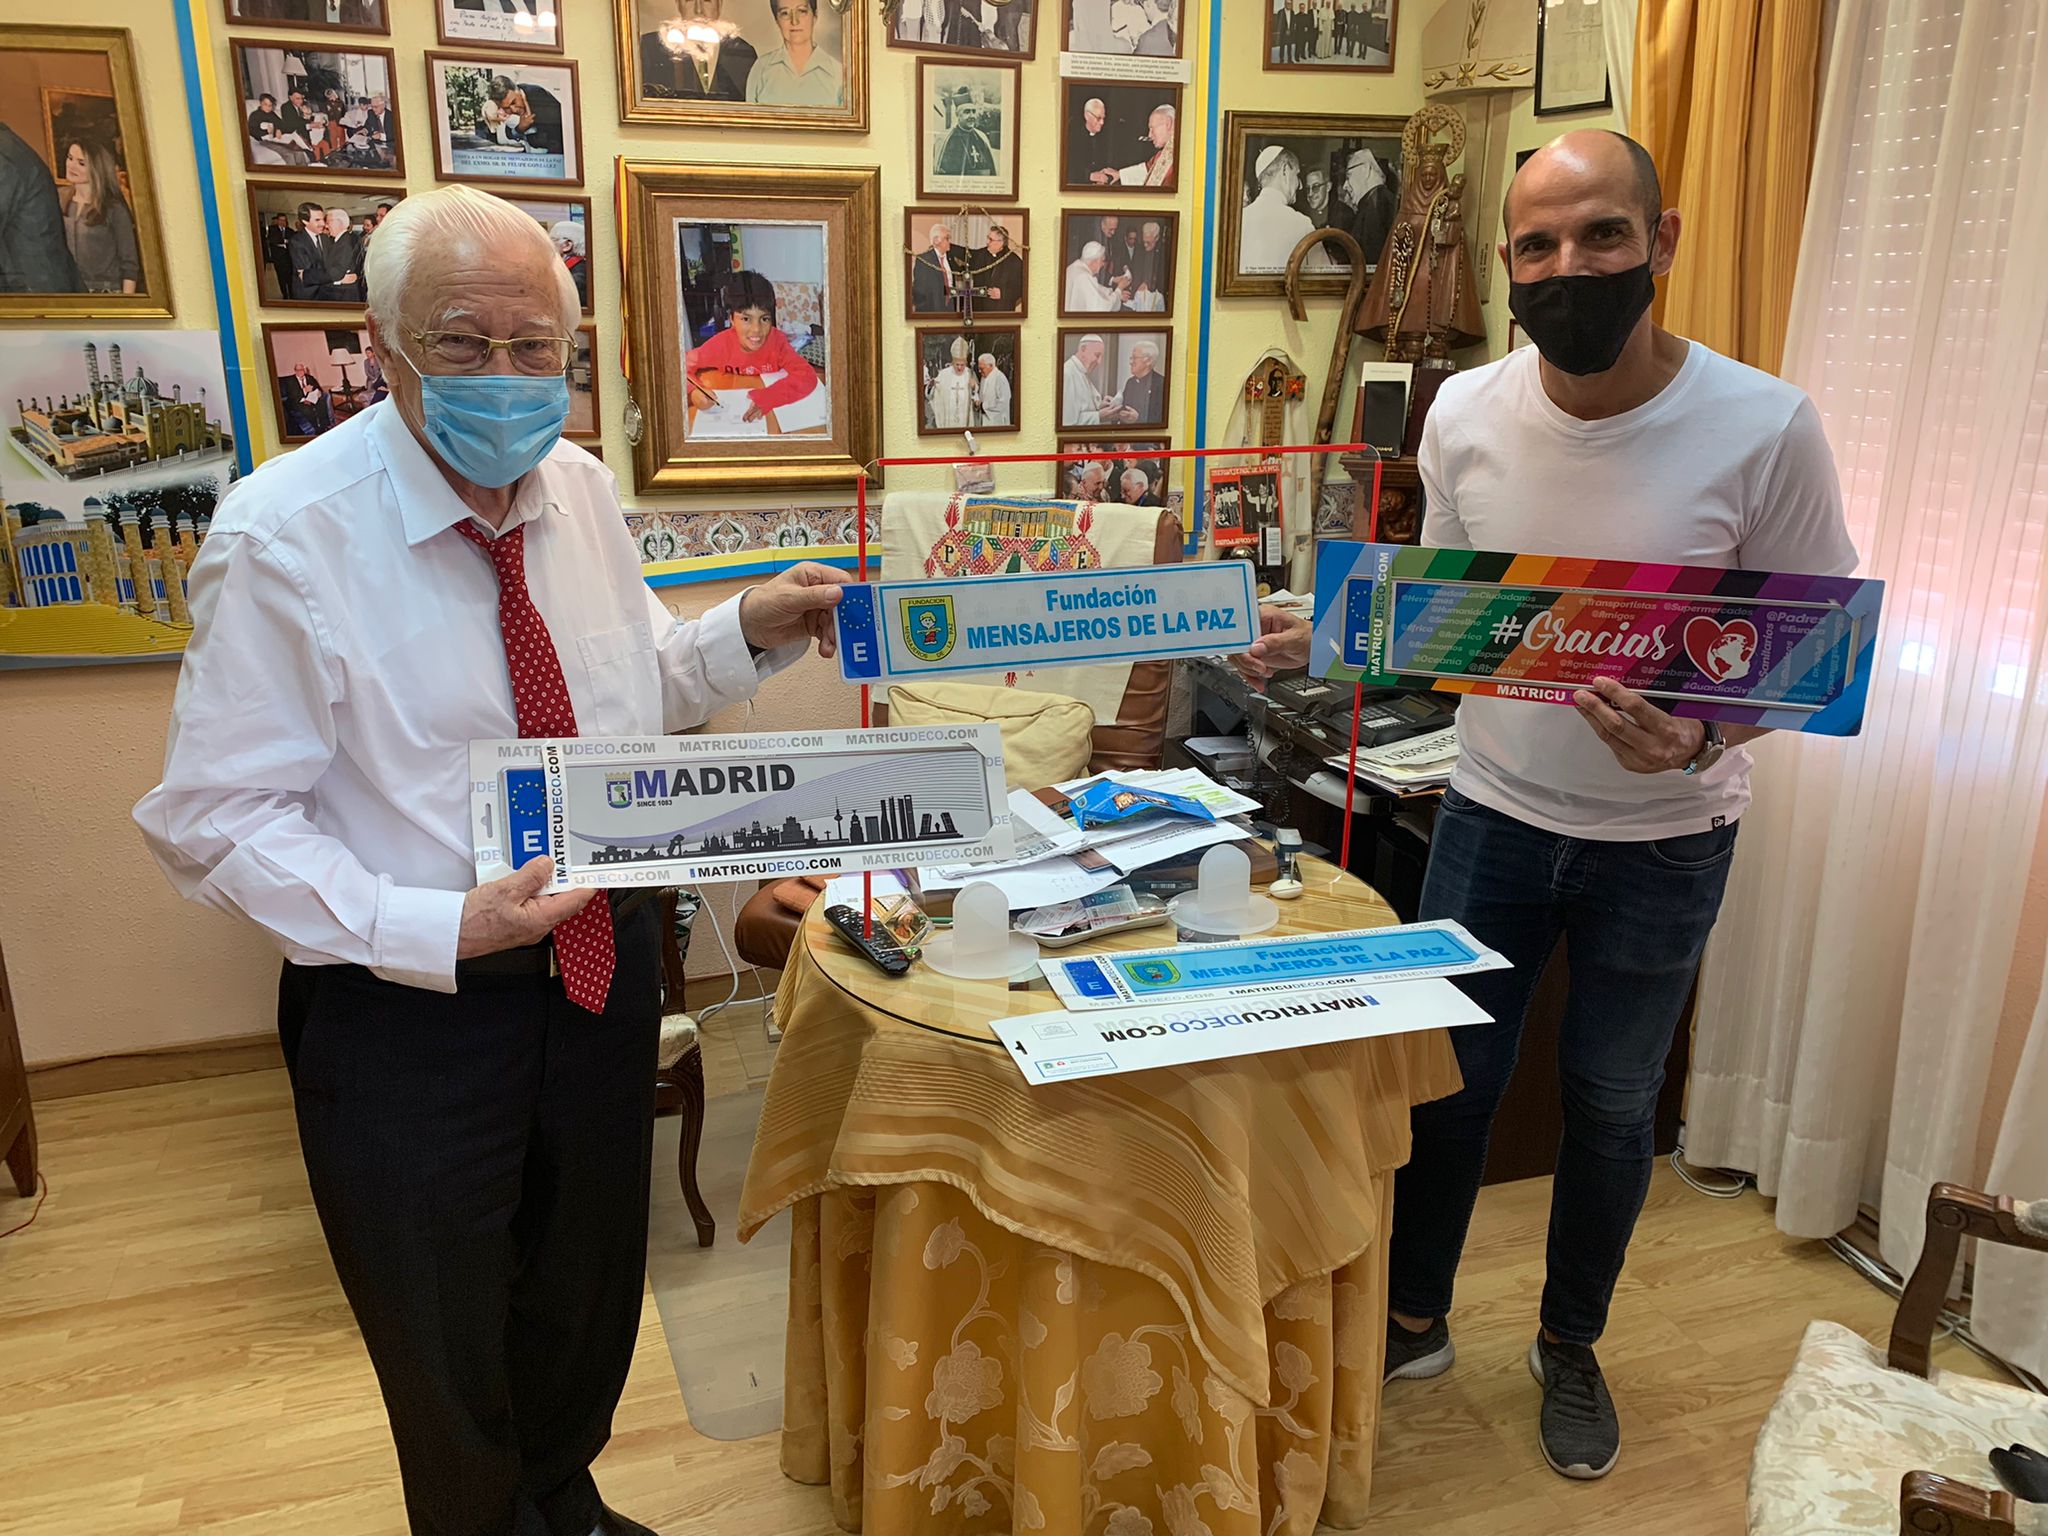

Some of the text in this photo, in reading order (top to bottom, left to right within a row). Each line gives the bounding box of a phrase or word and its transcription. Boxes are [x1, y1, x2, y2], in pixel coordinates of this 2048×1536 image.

[943, 544, 955, 564] P
[1077, 550, 1088, 570] E
[1046, 584, 1157, 612] Fundación
[1401, 594, 1455, 605] @Hermanos
[1579, 598, 1658, 610] @Transportistas
[1370, 551, 1390, 677] MATRICUDECO.COM
[1431, 605, 1492, 616] @Humanidad
[1591, 610, 1636, 621] @Amigos
[1663, 602, 1754, 616] @Supermercados
[1766, 610, 1827, 625] @Padres
[966, 607, 1237, 649] MENSAJEROS DE LA PAZ
[1489, 609, 1675, 662] #Gracias
[1779, 624, 1826, 636] @Europa
[1354, 631, 1369, 651] E
[852, 641, 868, 663] E
[1468, 649, 1509, 660] @España
[1758, 623, 1774, 687] @Sanitarios
[1468, 663, 1526, 677] @Abuelos
[1559, 659, 1624, 671] @Agricultores
[1640, 666, 1699, 679] @Bomberos
[679, 735, 824, 753] MATRICUDECO.COM
[846, 728, 979, 745] MATRICUDECO.COM
[497, 741, 656, 759] MATRUDECO.COM
[634, 763, 796, 799] MADRID
[546, 745, 568, 879] MATRICUDECO.COM
[636, 798, 673, 808] SINCE 1083
[522, 829, 543, 853] E
[862, 845, 994, 866] MATRICUDECO.COM
[698, 857, 842, 878] MATRICUDECO.COM
[1255, 942, 1364, 962] Fundación
[1189, 946, 1451, 980] MENSAJEROS DE LA PAZ
[1086, 981, 1103, 991] E
[1236, 977, 1357, 995] MATRICUDECO.COM
[1100, 995, 1369, 1043] MATRICUDECO.COM
